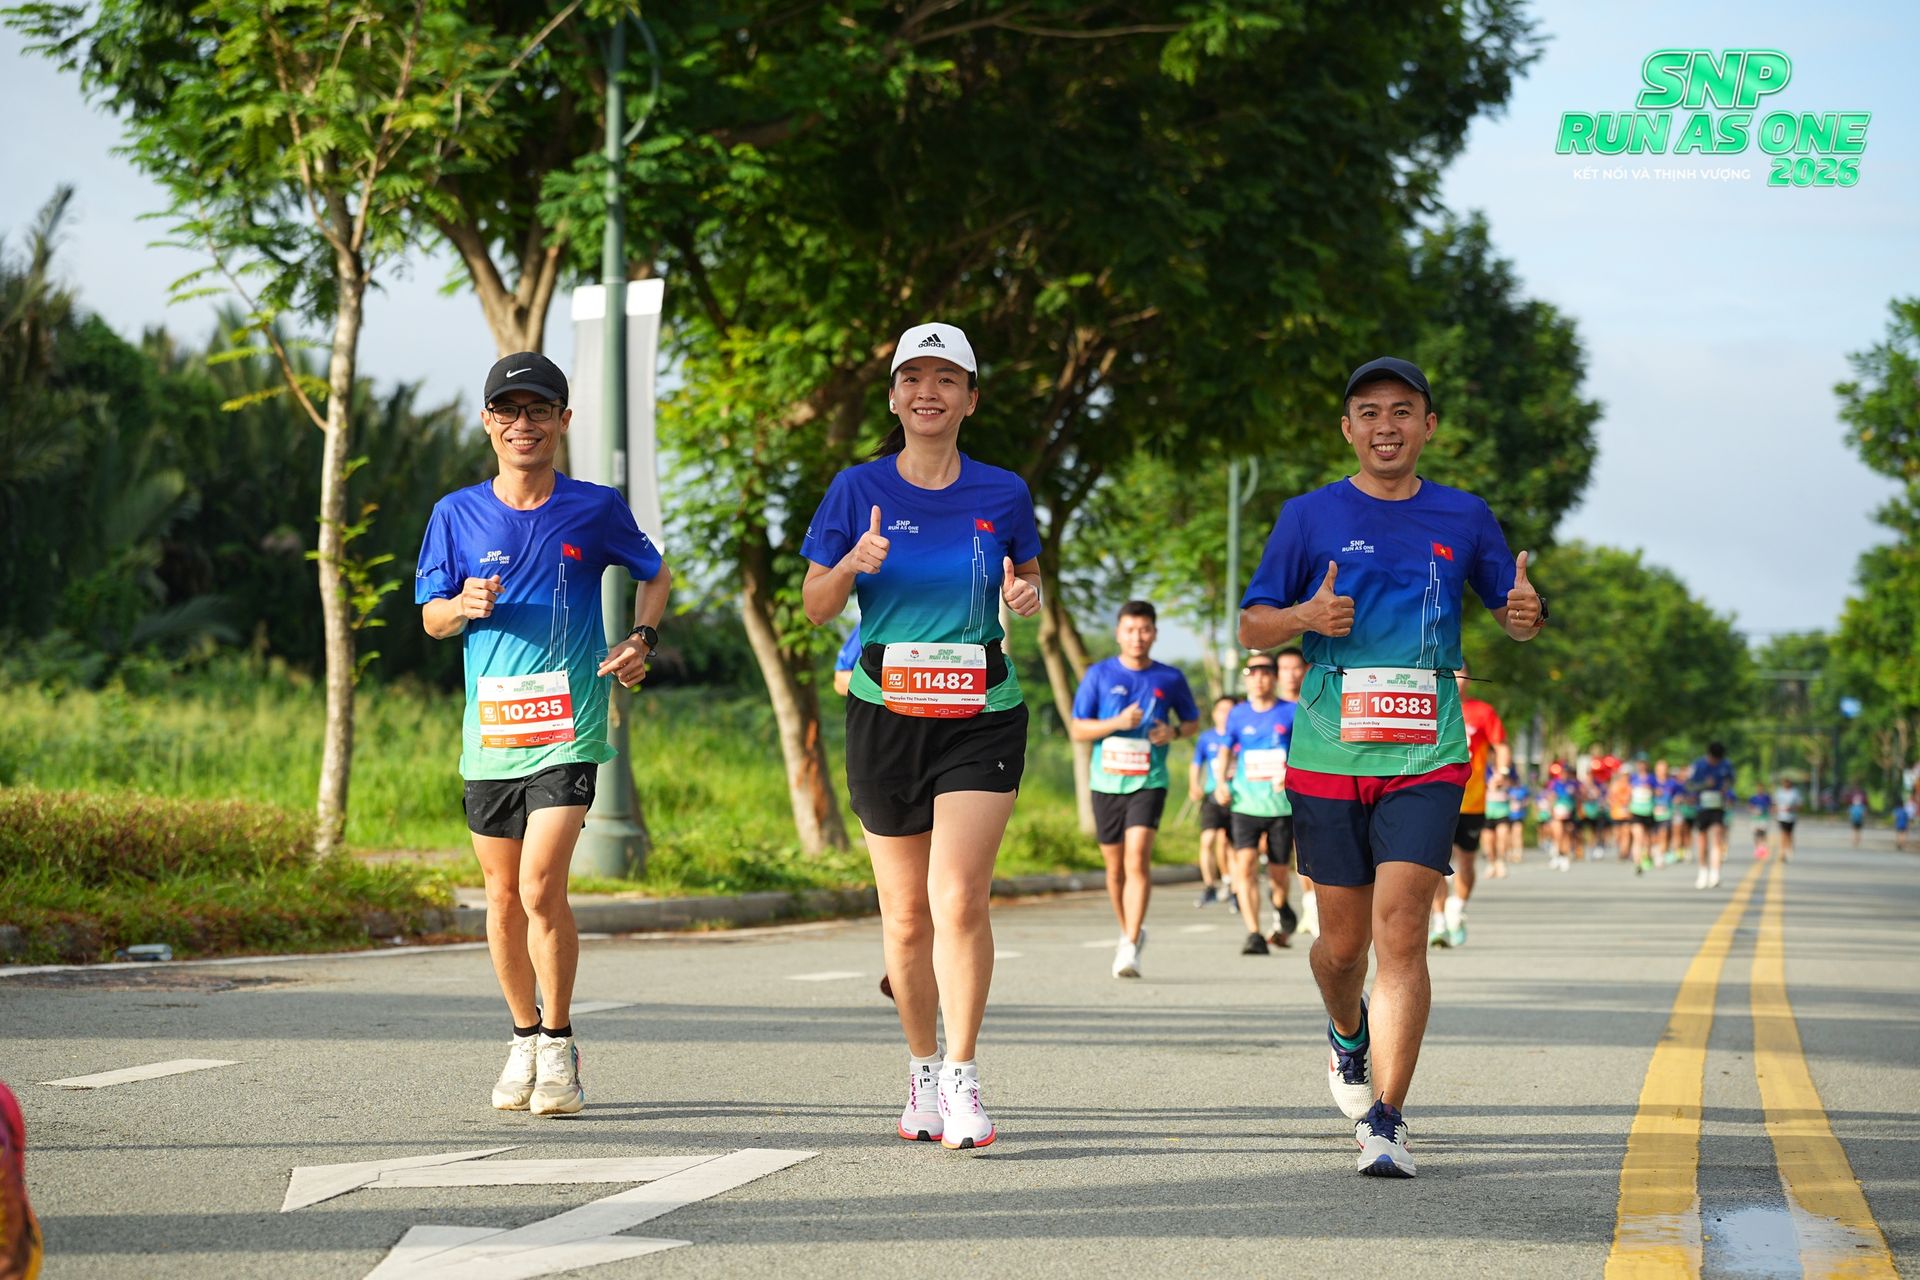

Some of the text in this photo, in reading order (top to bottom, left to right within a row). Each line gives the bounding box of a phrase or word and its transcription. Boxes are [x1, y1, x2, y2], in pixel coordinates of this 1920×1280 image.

[918, 341, 946, 349] adidas
[889, 673, 902, 681] 10
[912, 672, 974, 690] 11482
[1347, 698, 1361, 706] 10
[1371, 696, 1432, 715] 10383
[501, 699, 563, 721] 10235
